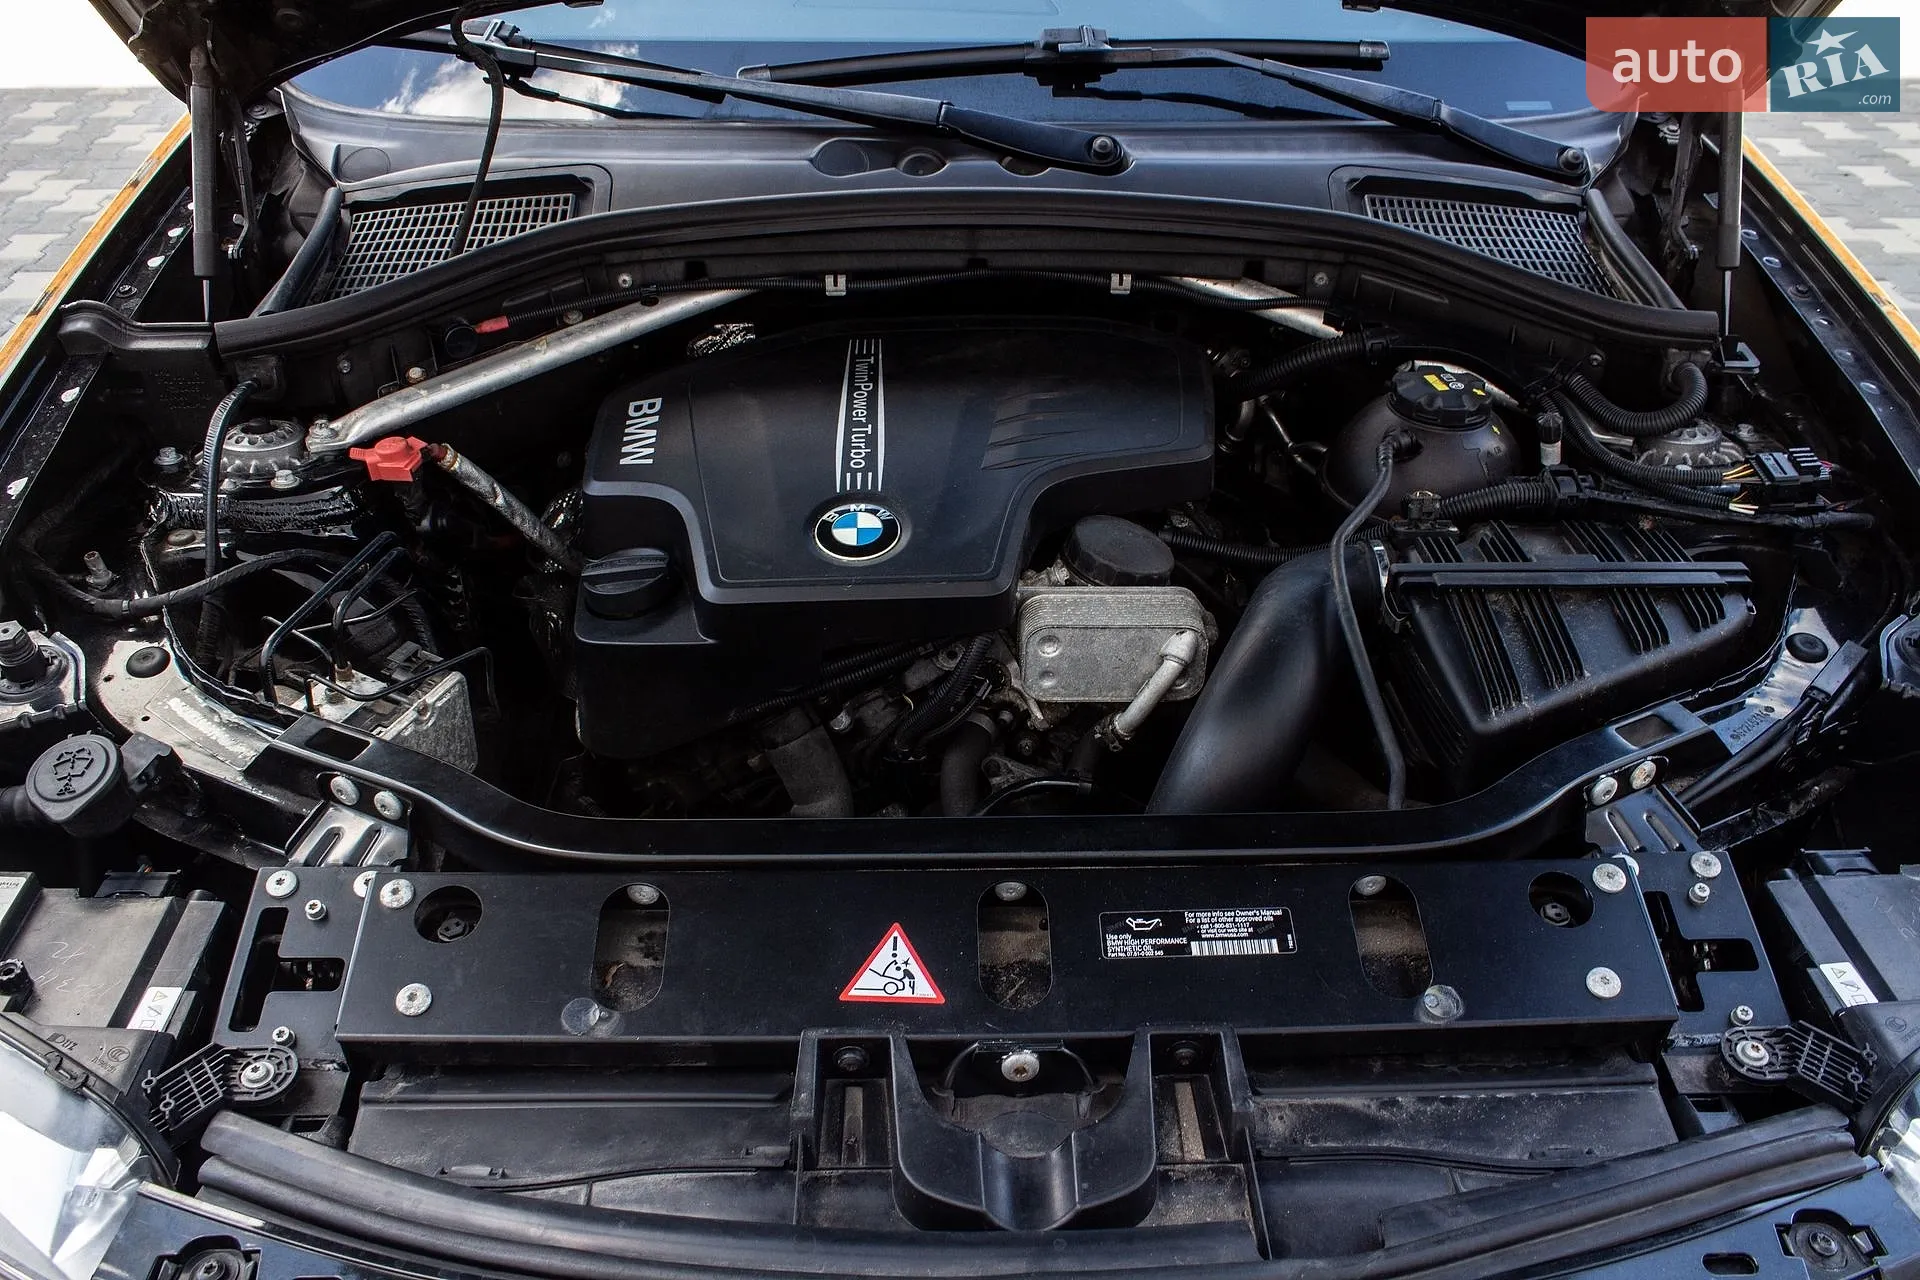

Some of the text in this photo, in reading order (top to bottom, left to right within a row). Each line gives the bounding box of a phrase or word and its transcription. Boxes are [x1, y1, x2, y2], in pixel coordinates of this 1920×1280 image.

[850, 356, 875, 469] TwinPower Turbo
[619, 397, 663, 465] BMW
[1235, 909, 1260, 917] Owner's
[1260, 908, 1283, 916] Manual
[1201, 916, 1211, 924] list
[1106, 939, 1123, 947] BMW
[1140, 937, 1188, 945] PERFORMANCE
[1107, 945, 1142, 953] SYNTHETIC
